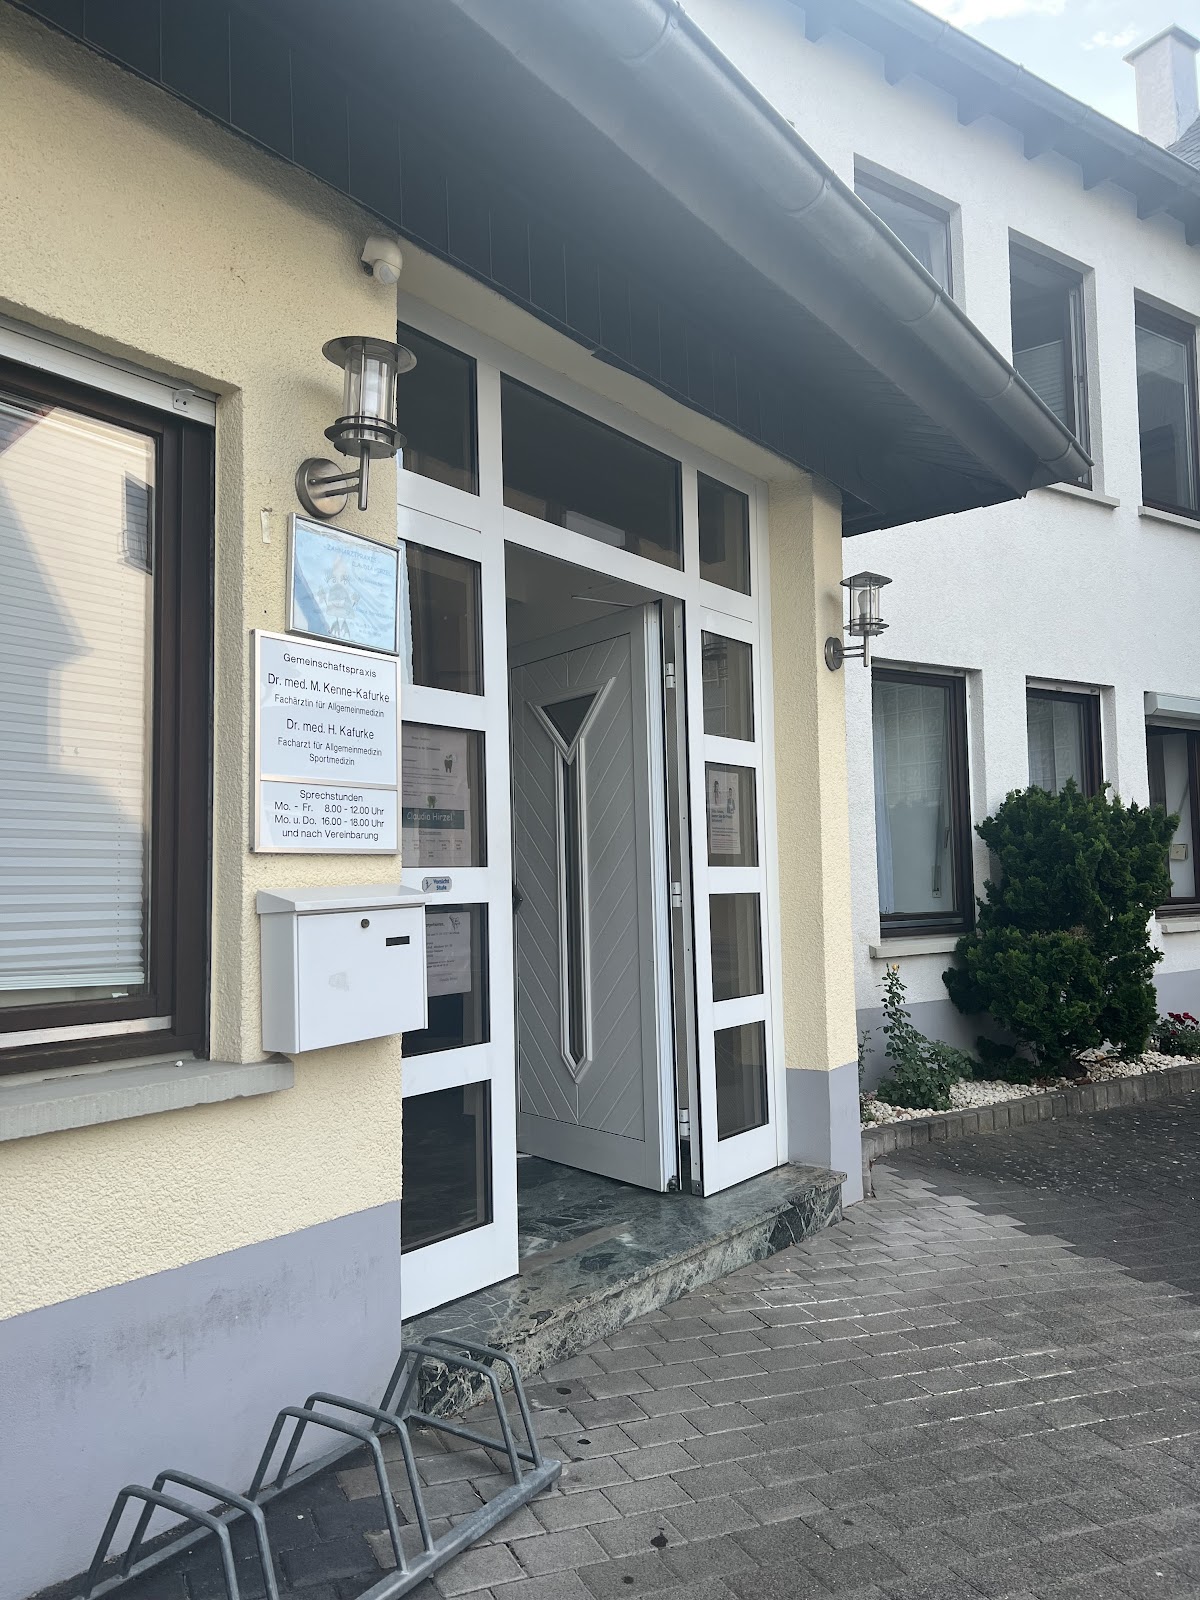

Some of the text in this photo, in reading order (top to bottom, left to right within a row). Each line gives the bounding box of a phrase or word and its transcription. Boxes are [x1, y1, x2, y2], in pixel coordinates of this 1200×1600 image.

[283, 653, 377, 678] Gemeinschaftspraxis
[267, 673, 390, 703] Dr. med. M. Kenne-Kafurke
[274, 693, 385, 718] Fachärztin für Allgemeinmedizin
[286, 718, 375, 740] Dr. med. H. Kafurke
[277, 737, 383, 757] Facharzt für Allgemeinmedizin
[309, 753, 355, 766] Sportmedizin
[299, 789, 363, 802] Sprechstunden
[274, 801, 291, 811] Mo.
[302, 803, 313, 812] Fr.
[324, 804, 342, 814] 8.00
[350, 805, 370, 815] 12.00
[371, 806, 384, 816] Uhr
[274, 815, 291, 824] Mo.
[302, 815, 317, 825] Do.
[321, 816, 342, 826] 16.00
[350, 818, 370, 827] 18.00
[371, 818, 384, 828] Uhr
[406, 811, 453, 822] Claudia Hirzel
[282, 829, 379, 841] und nach Vereinbarung
